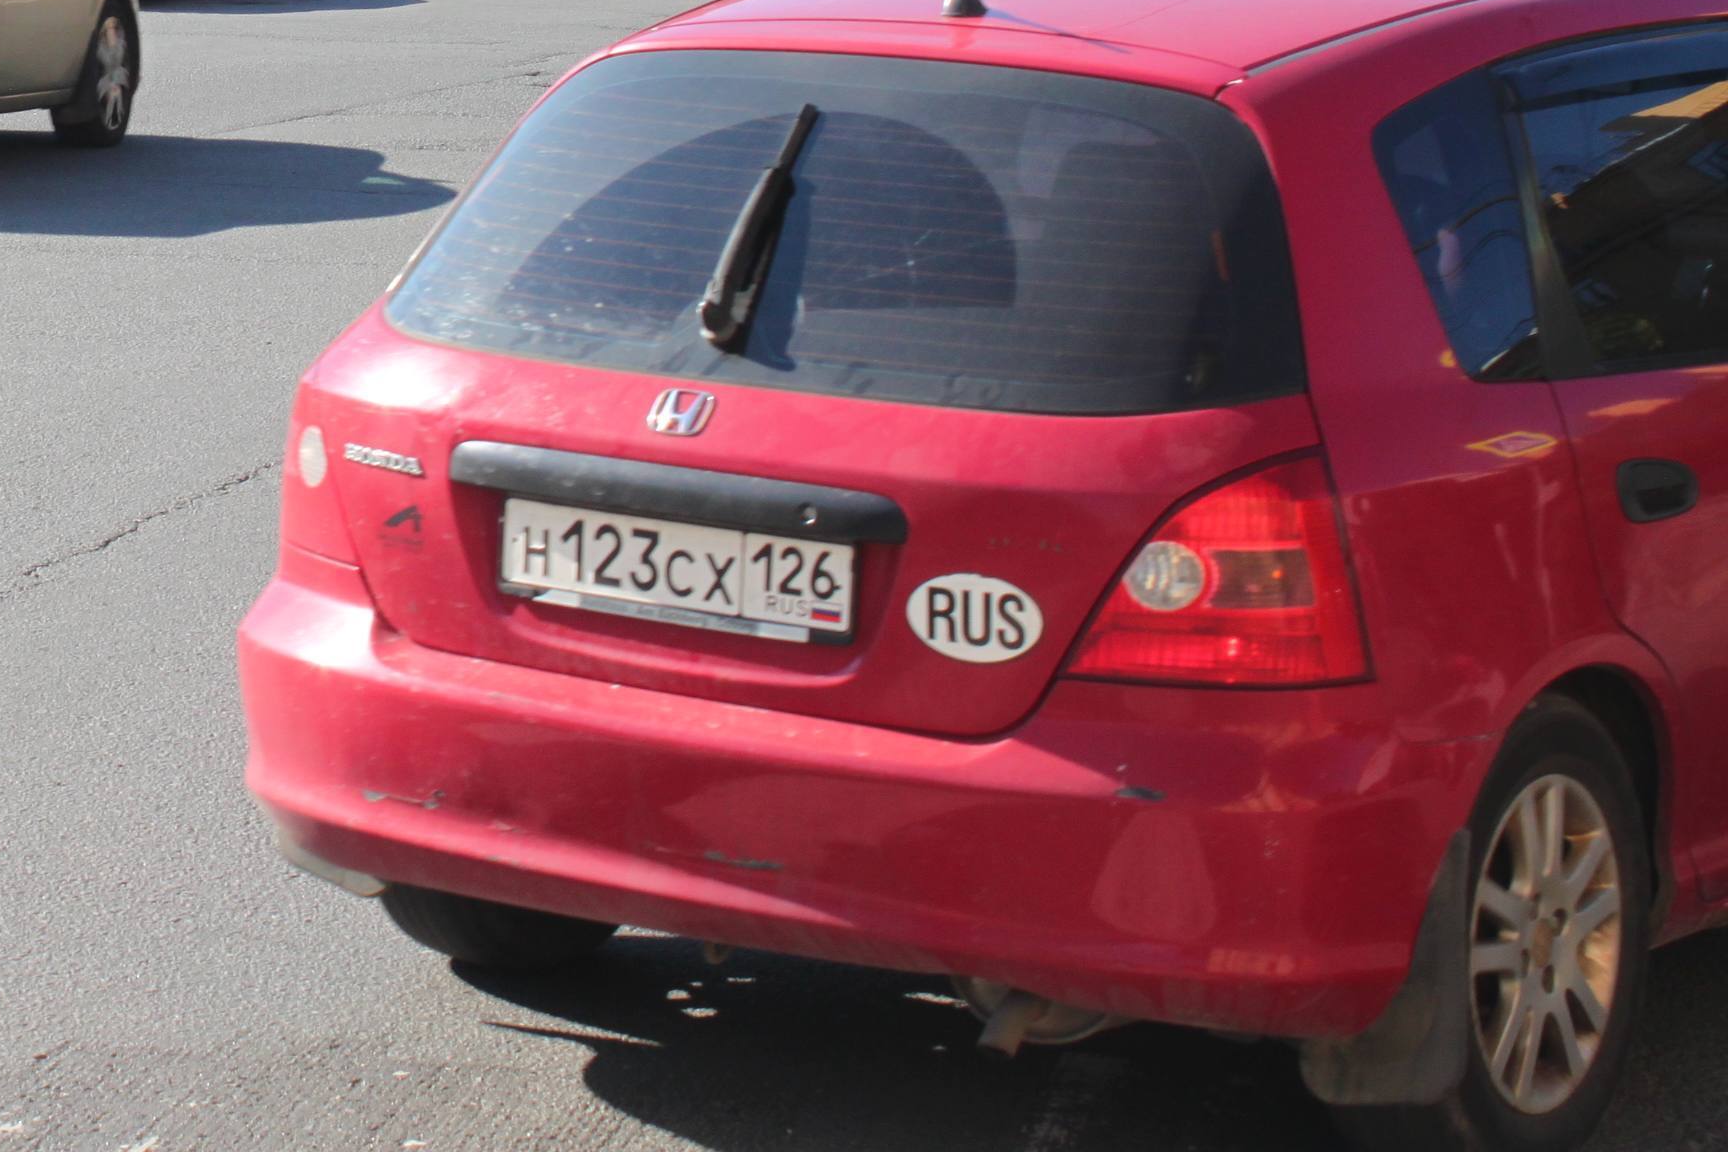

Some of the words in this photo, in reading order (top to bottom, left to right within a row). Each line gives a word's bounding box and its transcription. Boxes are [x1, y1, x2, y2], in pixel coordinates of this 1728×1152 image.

[343, 442, 425, 477] HONDA
[523, 519, 735, 605] Н123СХ
[751, 543, 838, 600] 126
[766, 595, 809, 616] RUS
[928, 586, 1025, 650] RUS
